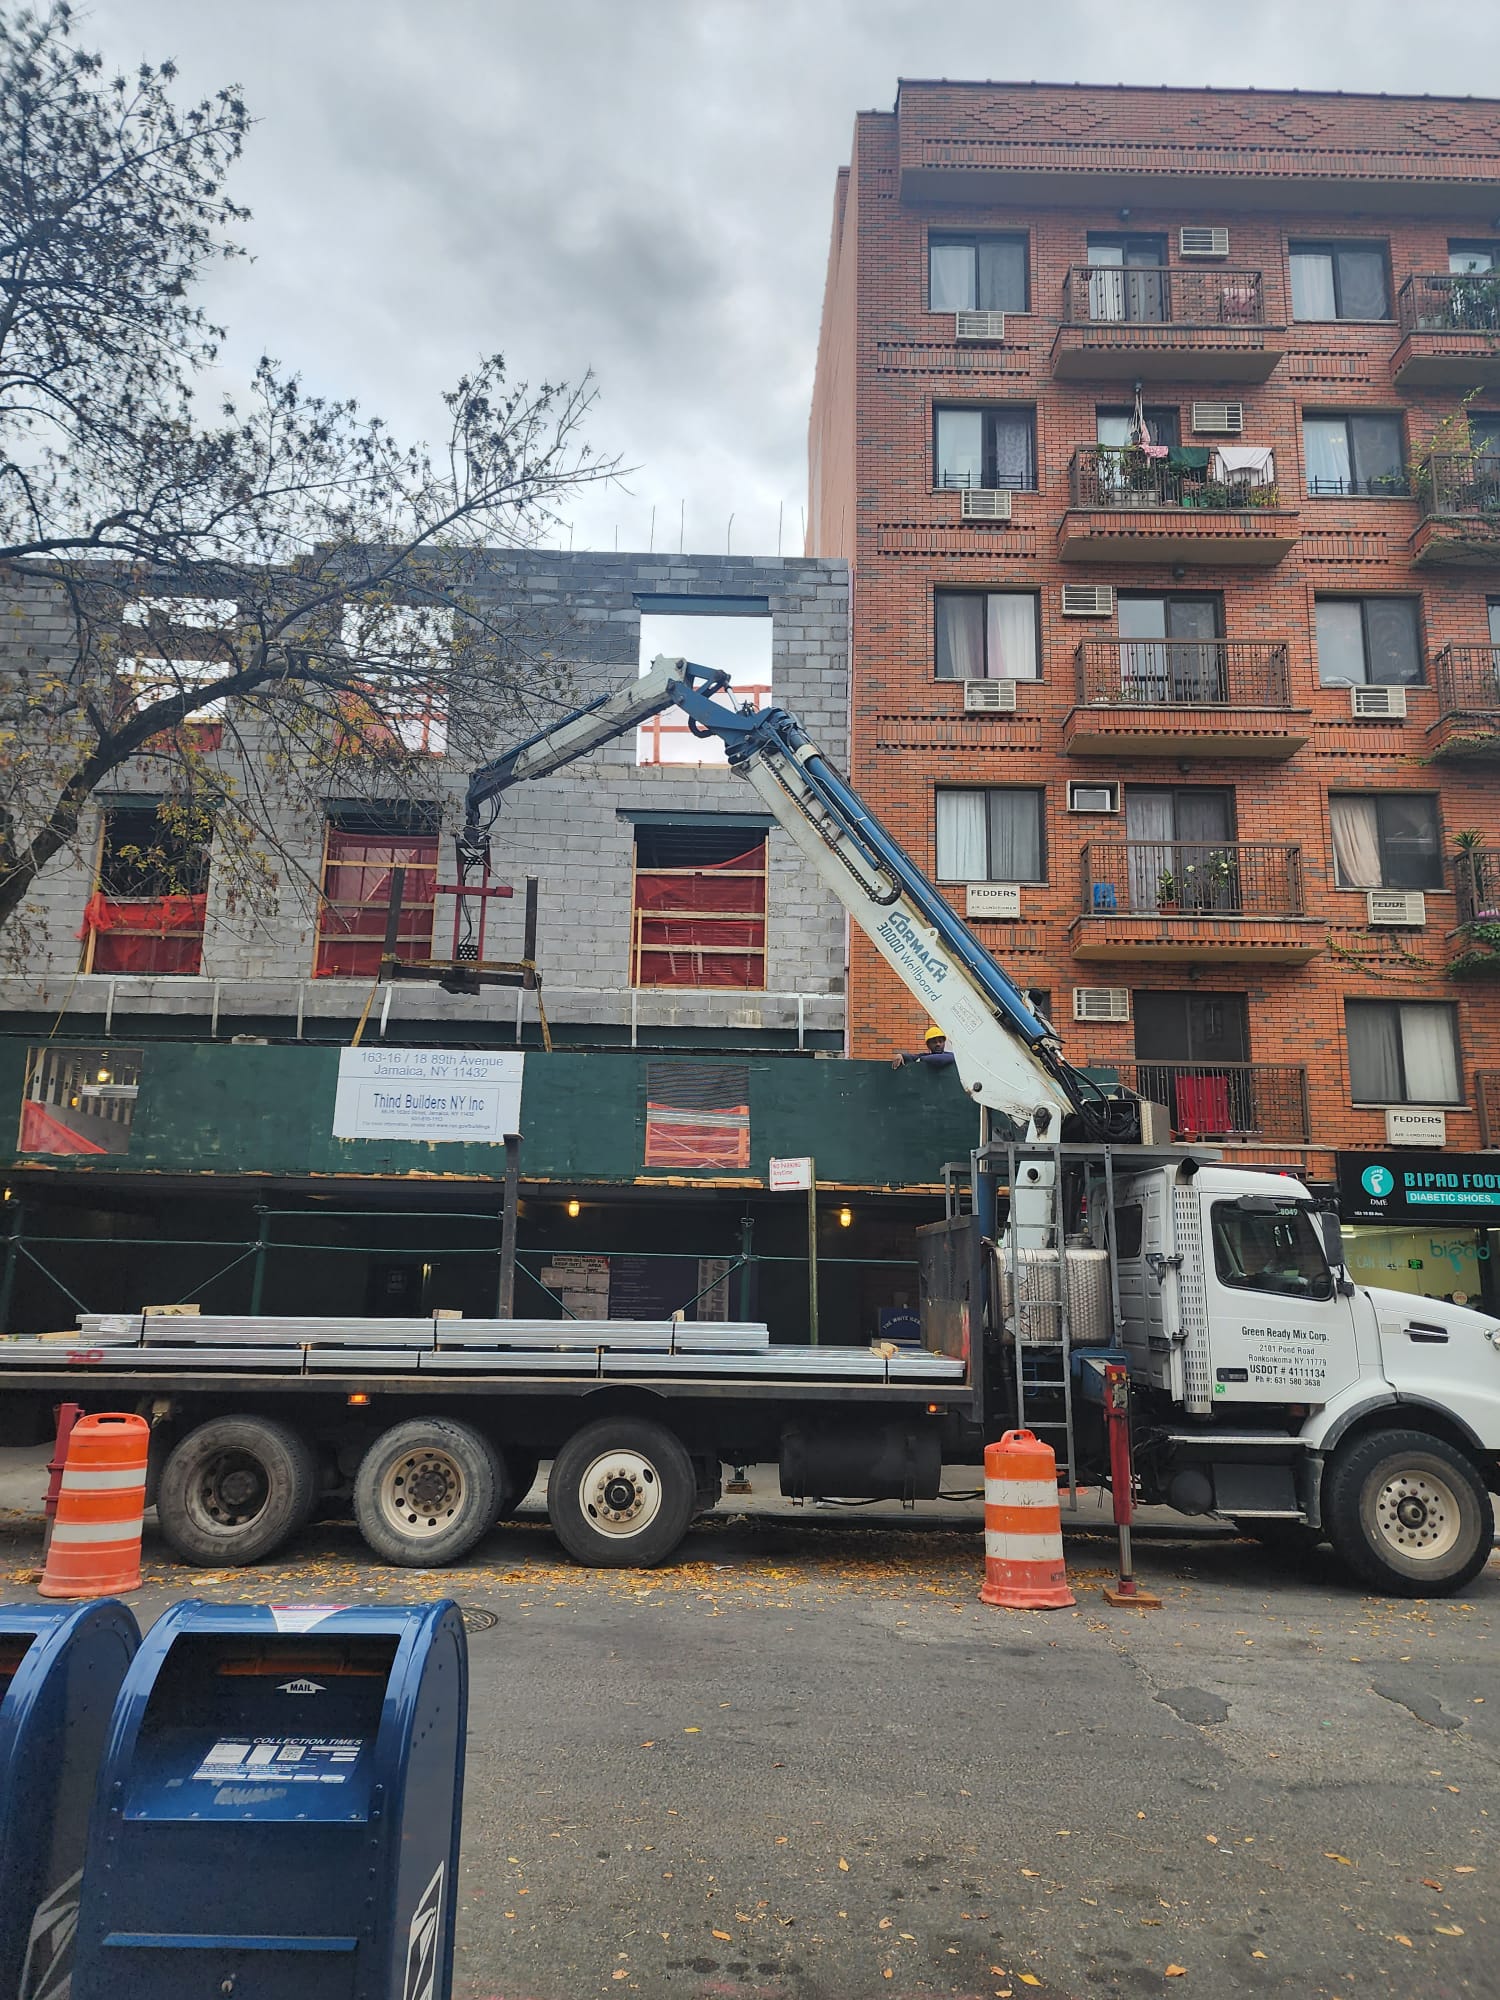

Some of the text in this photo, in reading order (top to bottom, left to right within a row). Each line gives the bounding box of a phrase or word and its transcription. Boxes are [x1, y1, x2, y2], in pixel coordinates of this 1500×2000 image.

[971, 889, 1017, 897] FEDDERS
[876, 921, 942, 1002] 30000 Wallboard
[361, 1051, 401, 1064] 163-16
[414, 1053, 428, 1064] 18
[431, 1054, 457, 1065] 89th
[459, 1055, 504, 1066] Avenue
[374, 1064, 488, 1078] Jamaica, NY 11432
[374, 1092, 485, 1110] Thind Builders NY Inc
[1393, 1115, 1442, 1124] FEDDERS
[1403, 1172, 1500, 1189] BIPAD FOOT
[1370, 1198, 1389, 1206] DME
[1410, 1192, 1495, 1204] DIABETIC SHOES,
[1241, 1326, 1330, 1342] Green Ready Mix Corp.
[1259, 1344, 1315, 1355] 2101 Pond Road
[1248, 1354, 1327, 1366] Ronkonkoma NY 11779
[1250, 1364, 1278, 1375] USDOT
[1288, 1368, 1326, 1378] 4111134
[1255, 1375, 1264, 1383] Ph
[1274, 1377, 1287, 1385] 631
[1289, 1377, 1302, 1386] 580
[289, 1683, 313, 1692] MAIL
[253, 1737, 326, 1745] COLLECTION
[327, 1738, 363, 1746] TIMES
